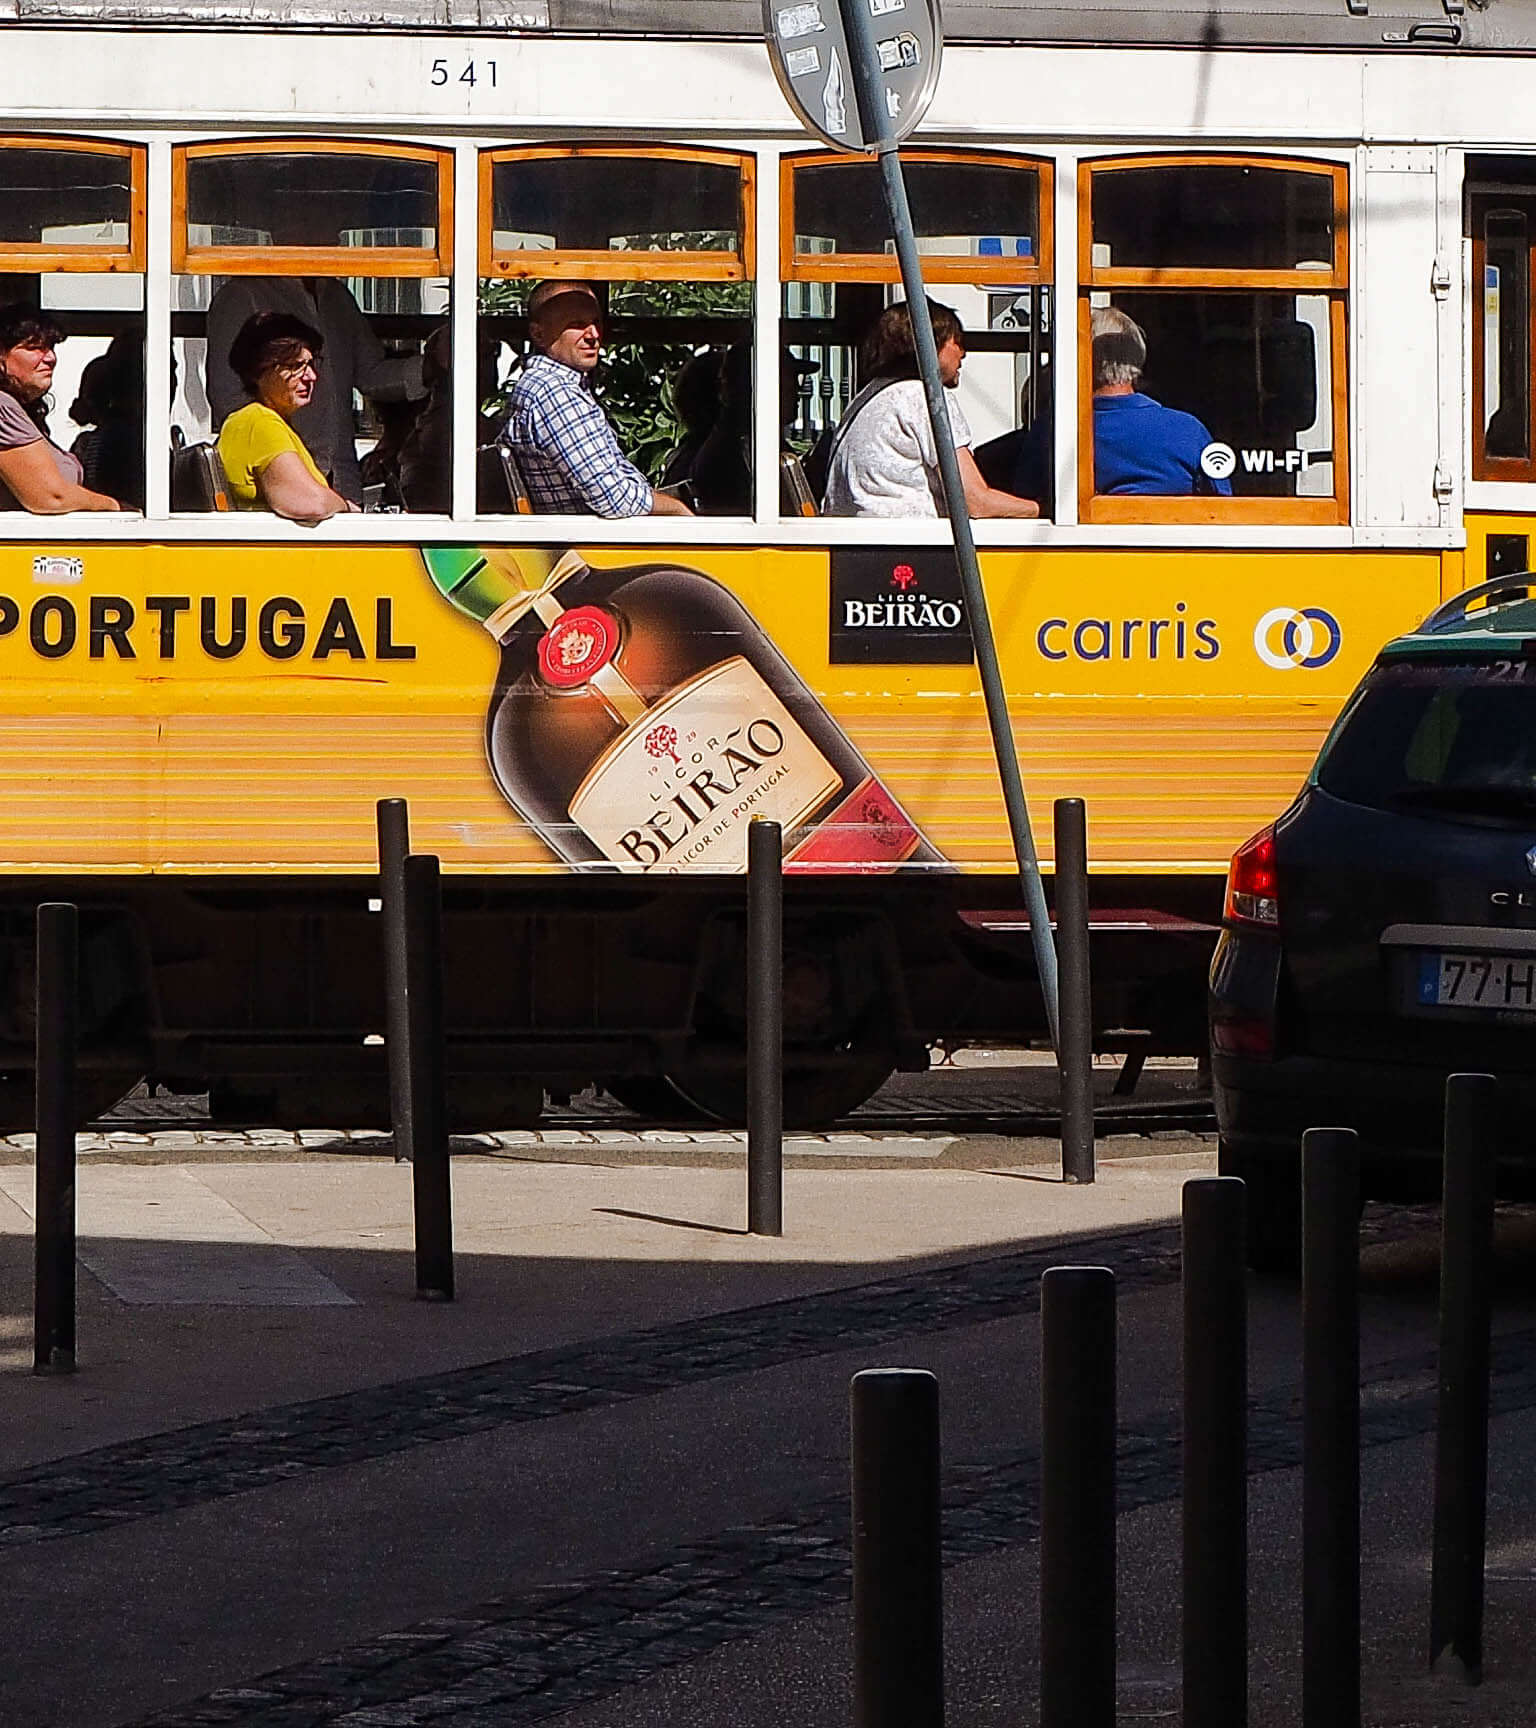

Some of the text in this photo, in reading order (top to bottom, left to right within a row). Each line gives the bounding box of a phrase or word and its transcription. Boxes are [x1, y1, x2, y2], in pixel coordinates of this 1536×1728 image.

[431, 59, 496, 87] 541
[1241, 449, 1309, 472] WI-FI
[878, 594, 927, 602] LICOR
[844, 599, 962, 628] BEIRÃO
[1036, 602, 1220, 660] carris
[1488, 661, 1528, 683] 21
[649, 736, 720, 802] LICOR
[616, 718, 785, 872] BEIRÃO
[713, 818, 730, 836] DE
[731, 764, 791, 819] PORTUGAL
